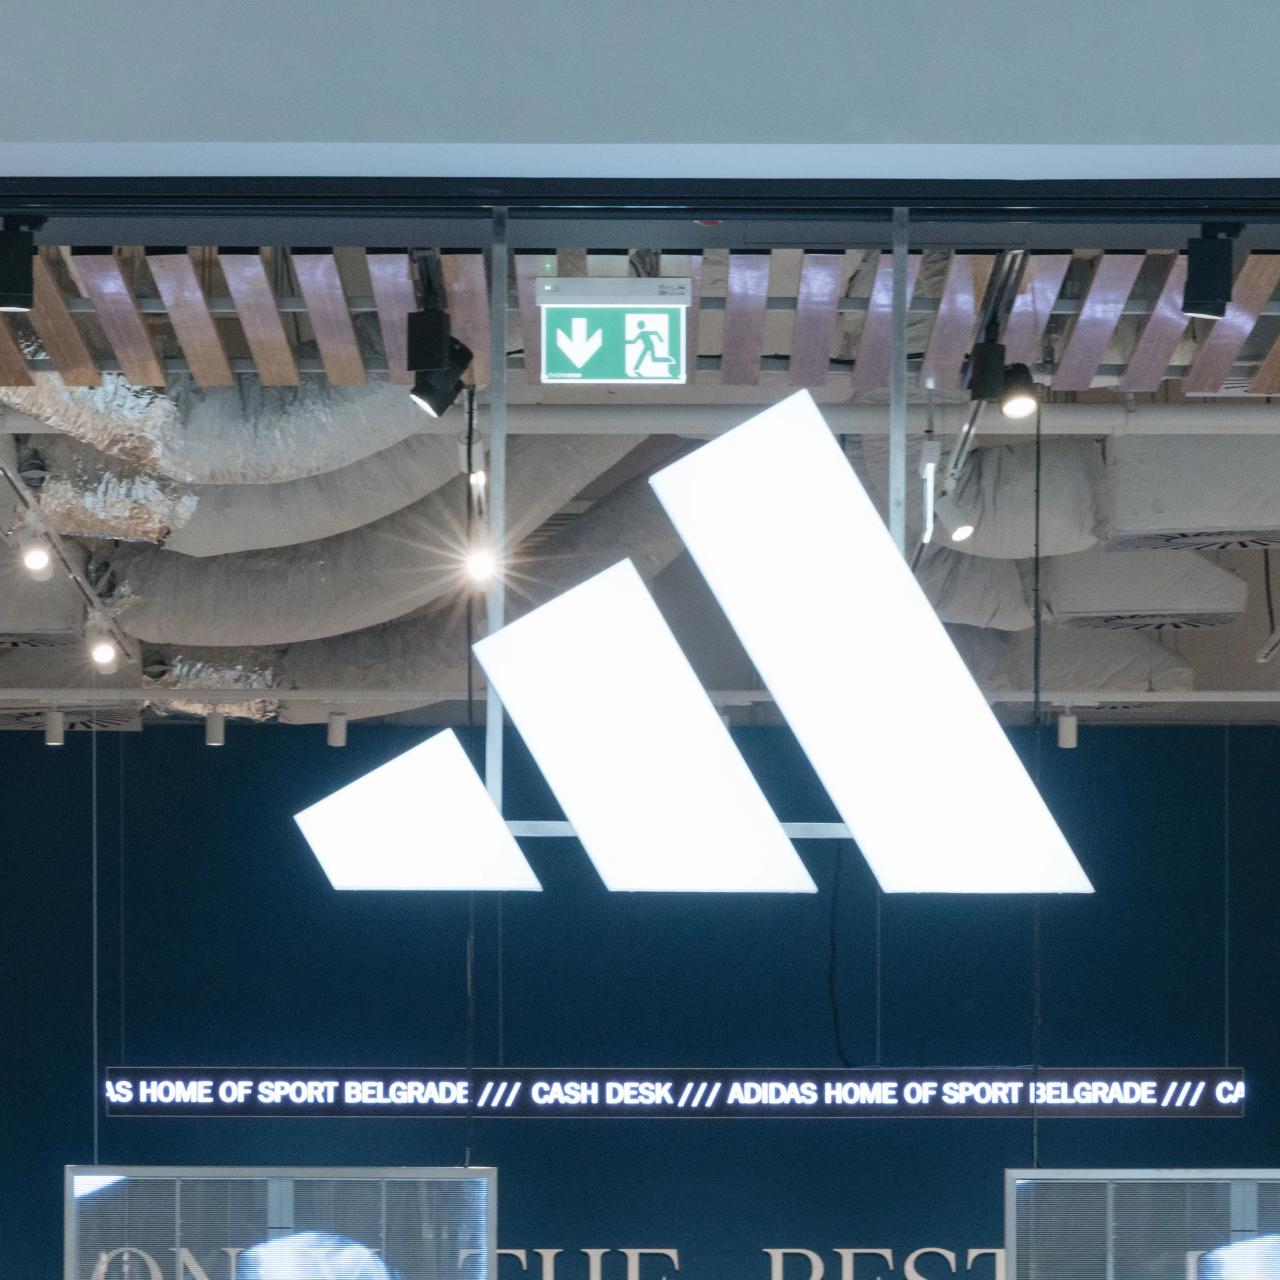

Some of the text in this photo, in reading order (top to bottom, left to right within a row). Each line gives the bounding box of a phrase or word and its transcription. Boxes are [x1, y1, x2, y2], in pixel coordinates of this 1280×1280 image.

[140, 1081, 213, 1105] HOME
[219, 1081, 253, 1105] OF
[258, 1081, 339, 1105] SPORT
[345, 1081, 468, 1105] BELGRADE
[531, 1081, 599, 1105] CASH
[605, 1081, 674, 1105] DESK
[726, 1081, 819, 1105] ADIDAS
[824, 1081, 899, 1105] HOME
[903, 1081, 938, 1105] OF
[941, 1081, 1024, 1105] SPORT
[1029, 1081, 1158, 1105] BELGRADE
